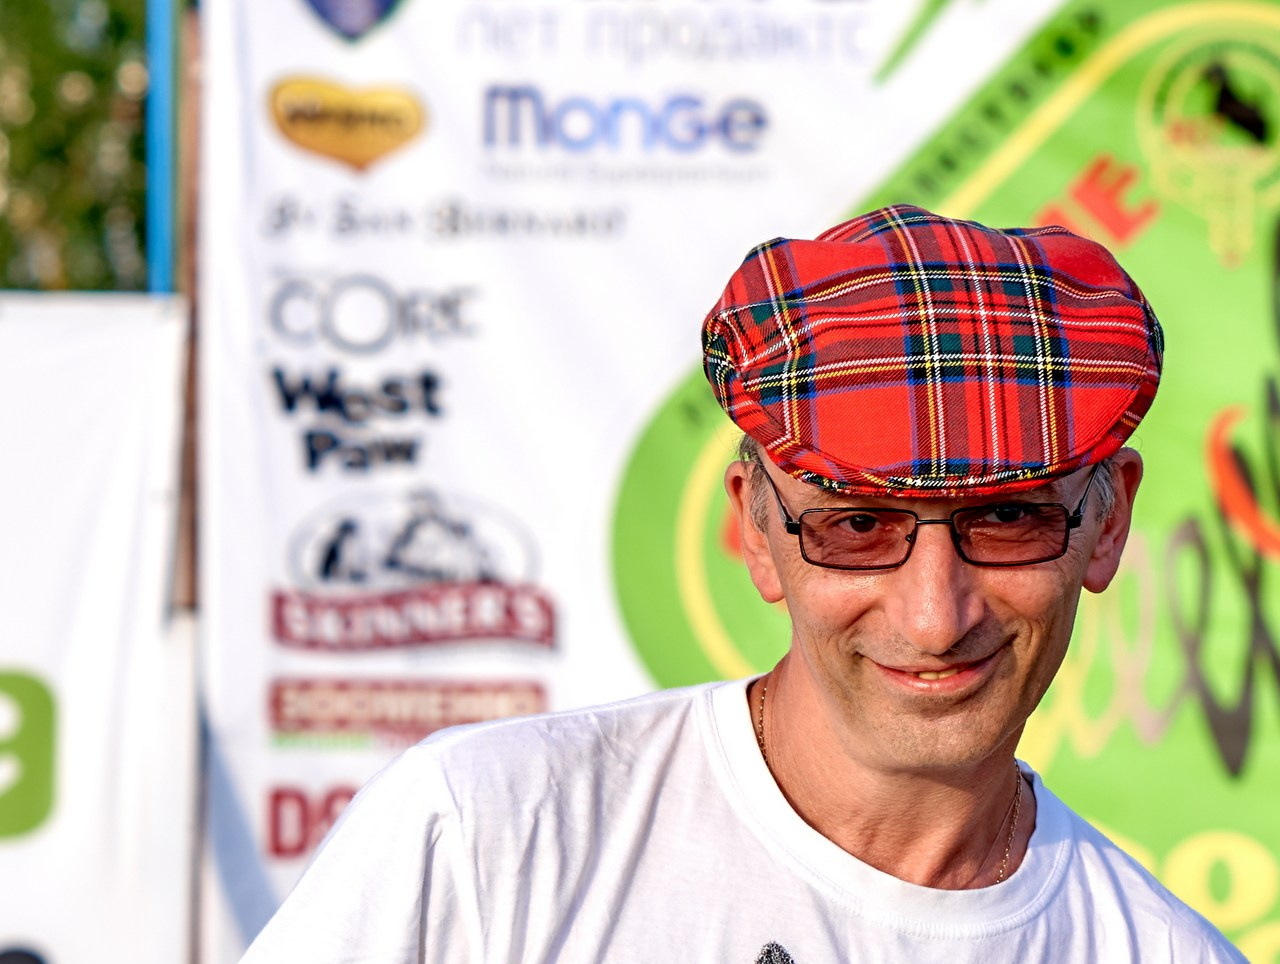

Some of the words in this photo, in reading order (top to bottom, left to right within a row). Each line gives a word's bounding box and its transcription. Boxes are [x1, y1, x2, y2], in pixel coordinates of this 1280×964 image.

[268, 271, 481, 357] CORE
[271, 367, 441, 421] West
[303, 429, 421, 473] Paw
